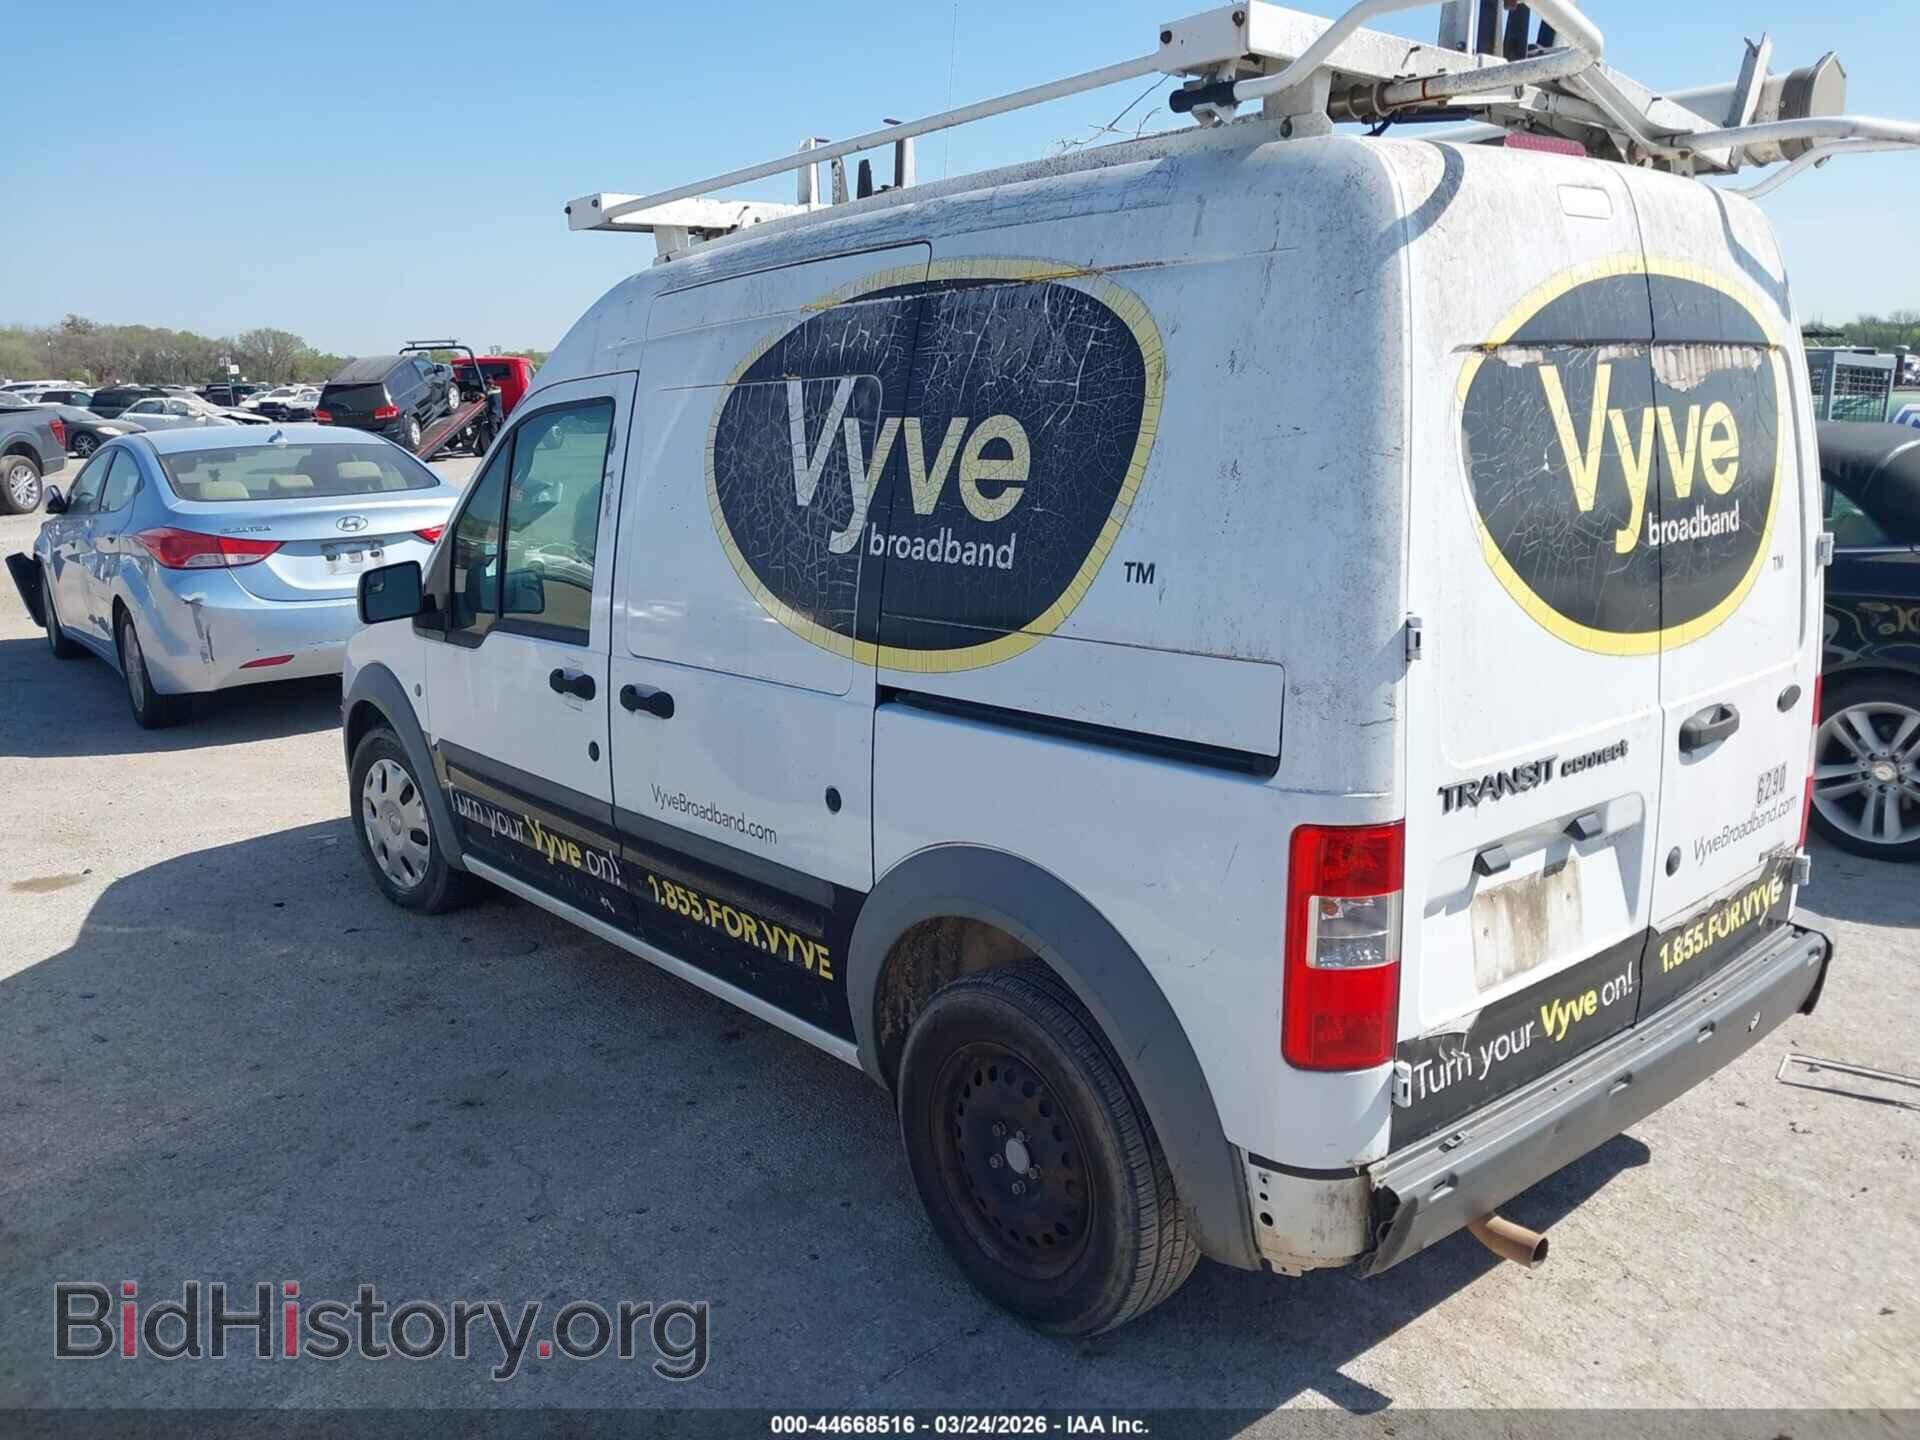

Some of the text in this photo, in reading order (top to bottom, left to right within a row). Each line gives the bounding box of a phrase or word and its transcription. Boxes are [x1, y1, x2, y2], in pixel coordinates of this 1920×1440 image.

[786, 374, 1031, 555] Vyve
[1538, 362, 1740, 555] Vyve
[869, 521, 1017, 571] broadband
[1648, 499, 1740, 547] broadband
[1123, 561, 1155, 585] TM
[1772, 556, 1784, 570] TM
[651, 783, 778, 846] VyveBroadband.com
[1437, 754, 1558, 815] TRANSIT
[487, 808, 524, 843] your
[524, 813, 582, 866] Vyve
[585, 849, 622, 886] on!
[1693, 795, 1797, 865] VyveBroadband.com
[648, 875, 834, 982] 1.855.FOR.VYVE
[1659, 878, 1785, 974] 1.855.FOR.VYVE
[1414, 961, 1634, 1101] Turn your Vyve on!
